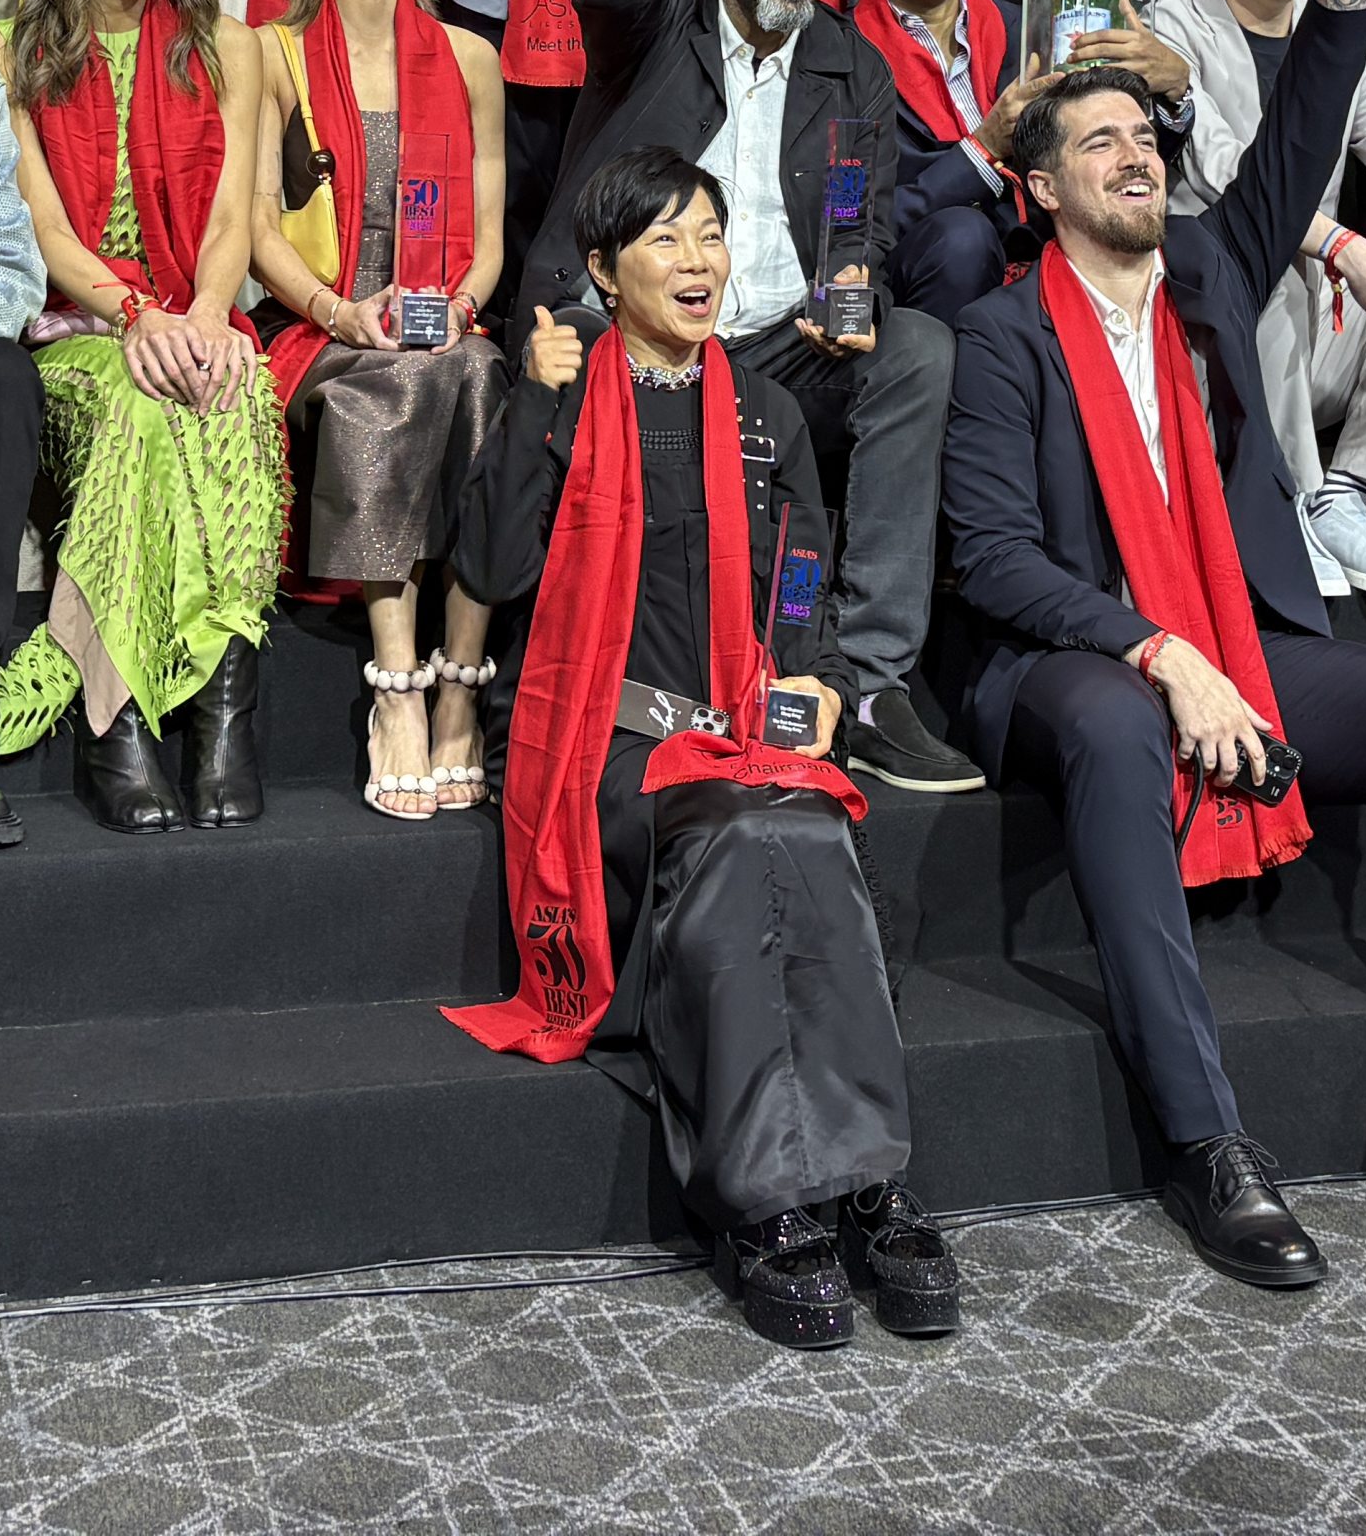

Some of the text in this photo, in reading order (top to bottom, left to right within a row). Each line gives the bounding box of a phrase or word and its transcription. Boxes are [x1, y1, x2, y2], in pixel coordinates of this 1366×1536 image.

[527, 36, 582, 53] Meet th
[403, 178, 440, 207] 50
[780, 557, 822, 588] 50
[781, 602, 812, 619] 2025
[530, 904, 577, 925] ASIA'S
[526, 924, 587, 992] 50
[543, 986, 589, 1021] BEST
